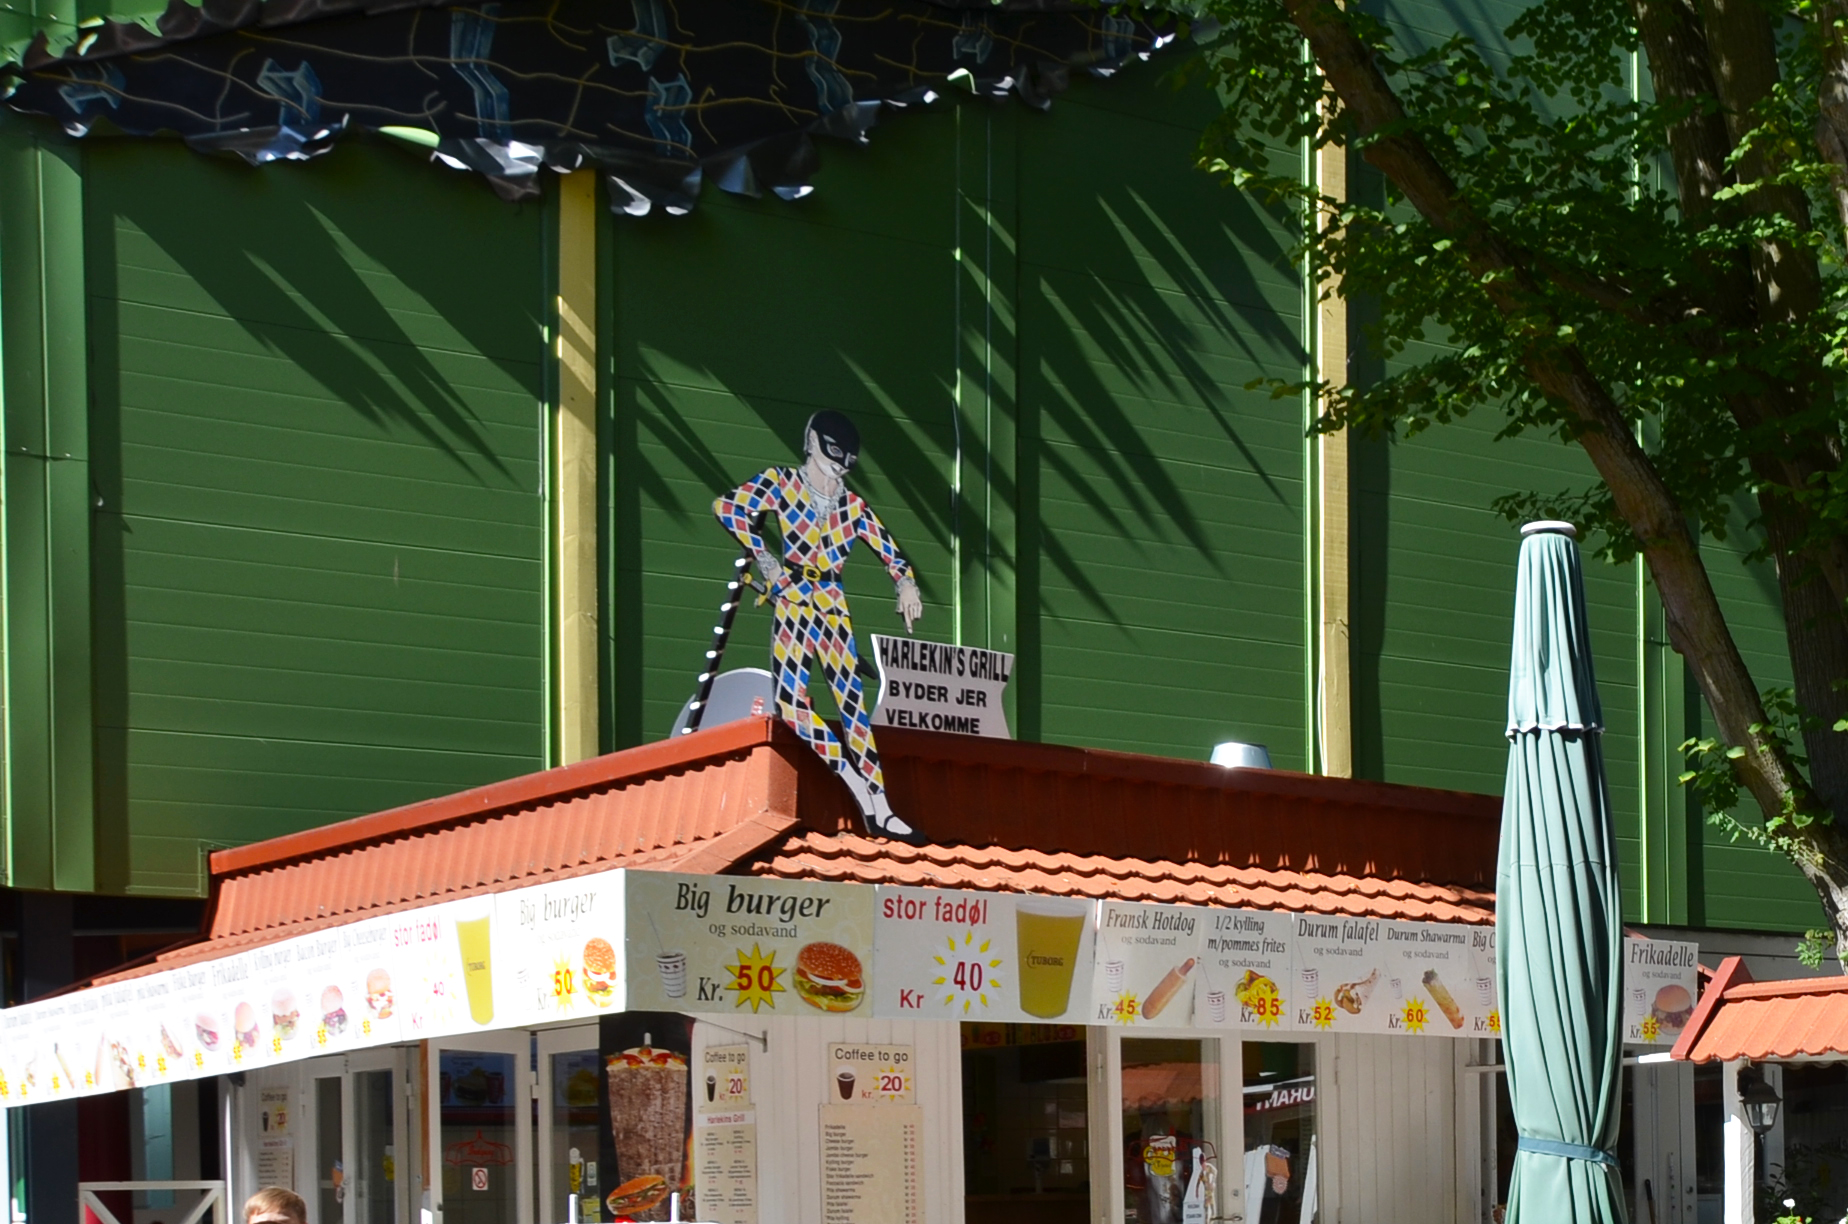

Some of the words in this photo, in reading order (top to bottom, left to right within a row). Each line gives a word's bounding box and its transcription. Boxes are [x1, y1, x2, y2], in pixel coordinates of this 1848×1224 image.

[880, 638, 965, 677] HARLEKIN'S
[969, 650, 1009, 683] GRILL
[888, 680, 949, 703] BYDER
[956, 686, 987, 708] JER
[886, 708, 980, 734] VELKOMME
[520, 900, 536, 930] Big
[544, 891, 597, 923] burger
[675, 882, 711, 917] Big
[726, 885, 830, 921] burger
[883, 894, 927, 920] stor
[935, 895, 989, 926] fadøl
[708, 924, 727, 938] og
[730, 922, 798, 939] sodavand
[1106, 908, 1148, 930] Fransk
[1152, 911, 1195, 936] Hotdog
[1215, 915, 1231, 931] 1/2
[1233, 916, 1264, 936] kylling
[1299, 917, 1338, 940] Durum
[1341, 921, 1380, 945] falafel
[1121, 936, 1133, 946] og
[1135, 934, 1176, 946] sodavand
[1207, 936, 1260, 955] m/pommes
[1262, 938, 1286, 954] frites
[1387, 928, 1417, 944] Durum
[1420, 927, 1467, 946] Shawarma
[1030, 956, 1064, 967] TUBORG
[1631, 943, 1694, 968] Frikadelle
[554, 968, 573, 996] 50
[697, 976, 724, 1001] Kr.
[737, 970, 774, 992] 50
[953, 961, 982, 991] 40
[900, 989, 924, 1009] Kr
[1115, 1000, 1136, 1015] 45
[1256, 997, 1281, 1017] 85
[1313, 1006, 1333, 1021] 52
[1406, 1008, 1424, 1023] 60
[1641, 1022, 1657, 1035] 55
[834, 1048, 874, 1061] Coffee
[878, 1049, 891, 1062] to
[894, 1051, 909, 1065] go
[861, 1089, 874, 1099] kr.
[880, 1076, 902, 1092] 20
